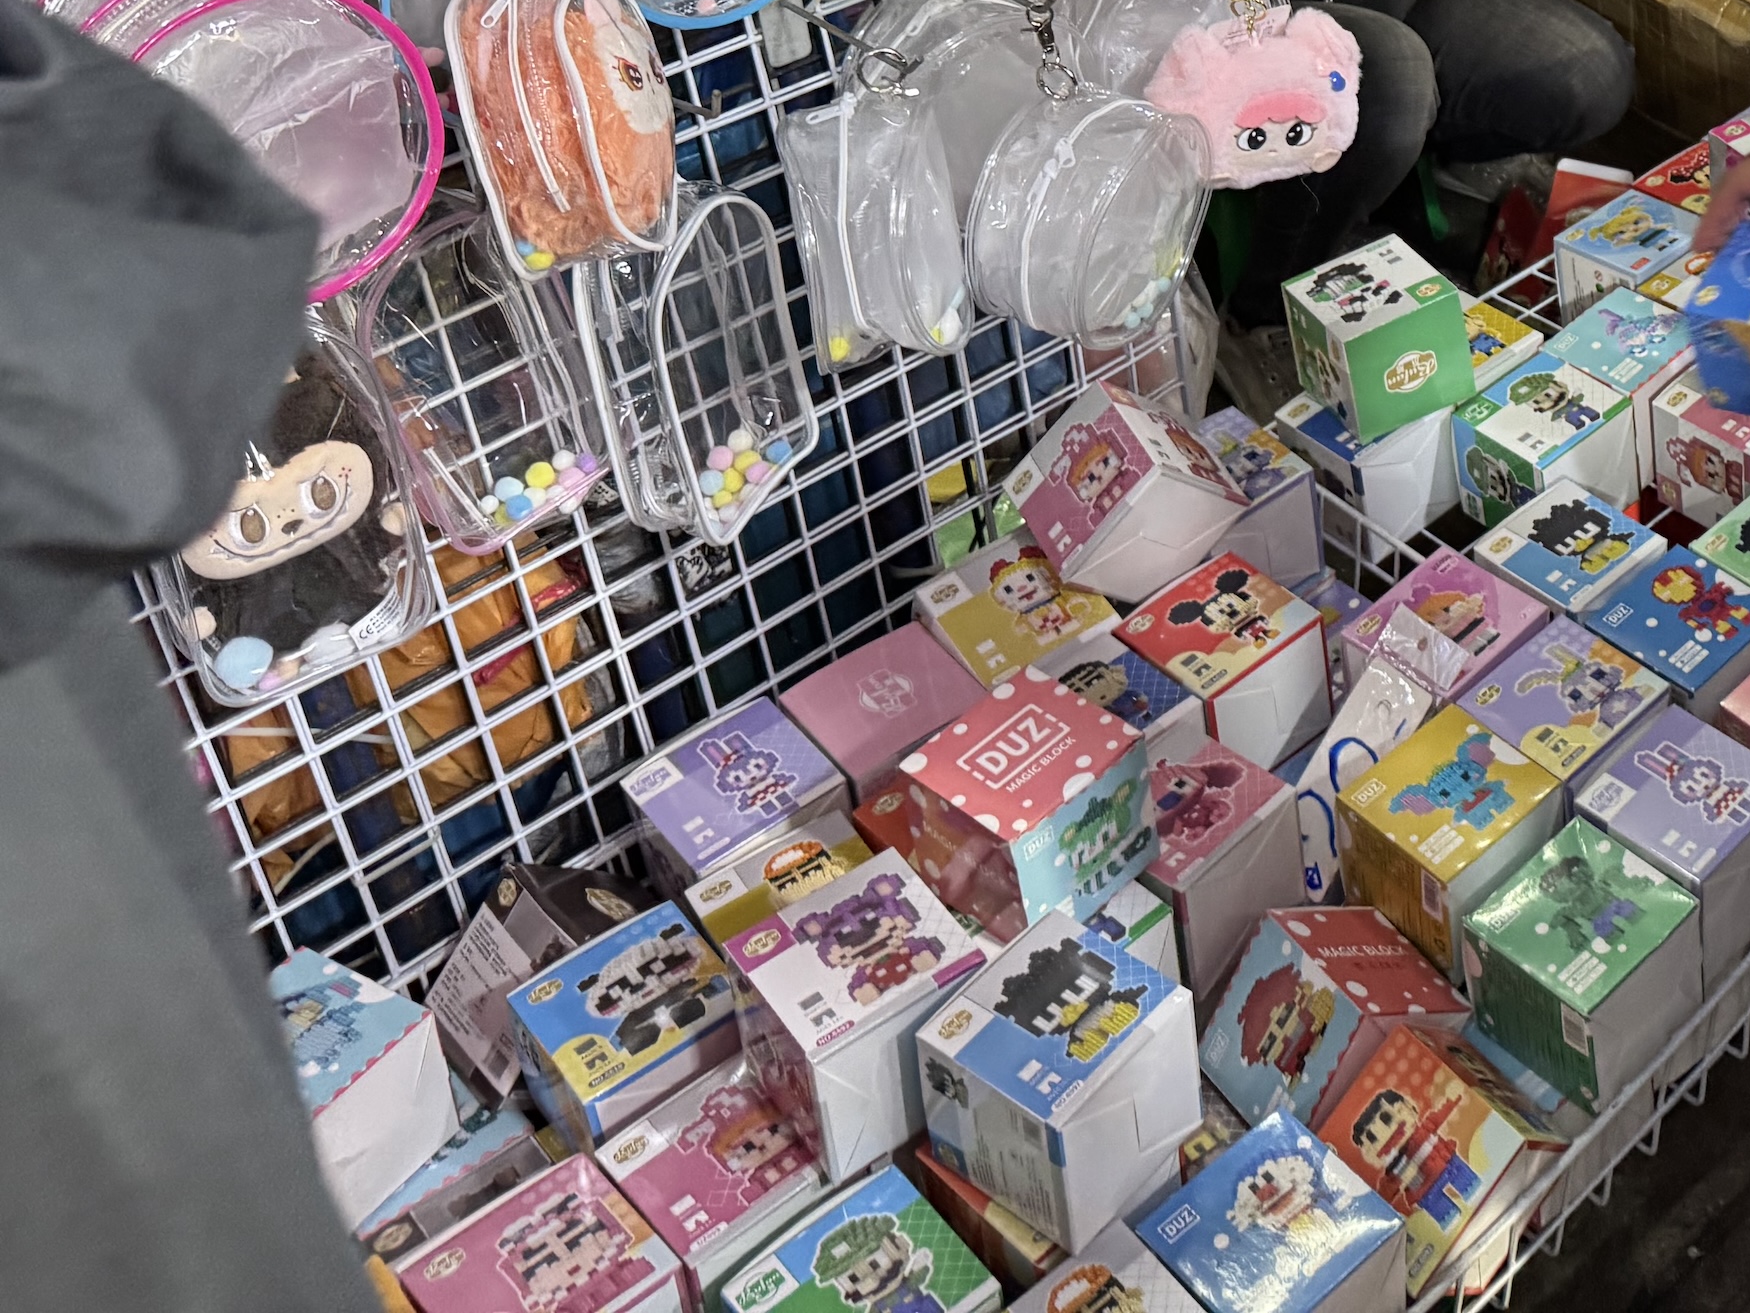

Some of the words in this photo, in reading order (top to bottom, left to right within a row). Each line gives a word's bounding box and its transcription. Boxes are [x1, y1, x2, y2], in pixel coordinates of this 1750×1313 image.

[1608, 606, 1629, 624] DUZ
[975, 716, 1052, 776] DUZ
[1005, 764, 1042, 793] MAGIC
[1040, 736, 1077, 768] BLOCK
[1357, 781, 1381, 804] DUZ
[1317, 945, 1364, 958] MAGIC
[1165, 1209, 1194, 1237] DUZ
